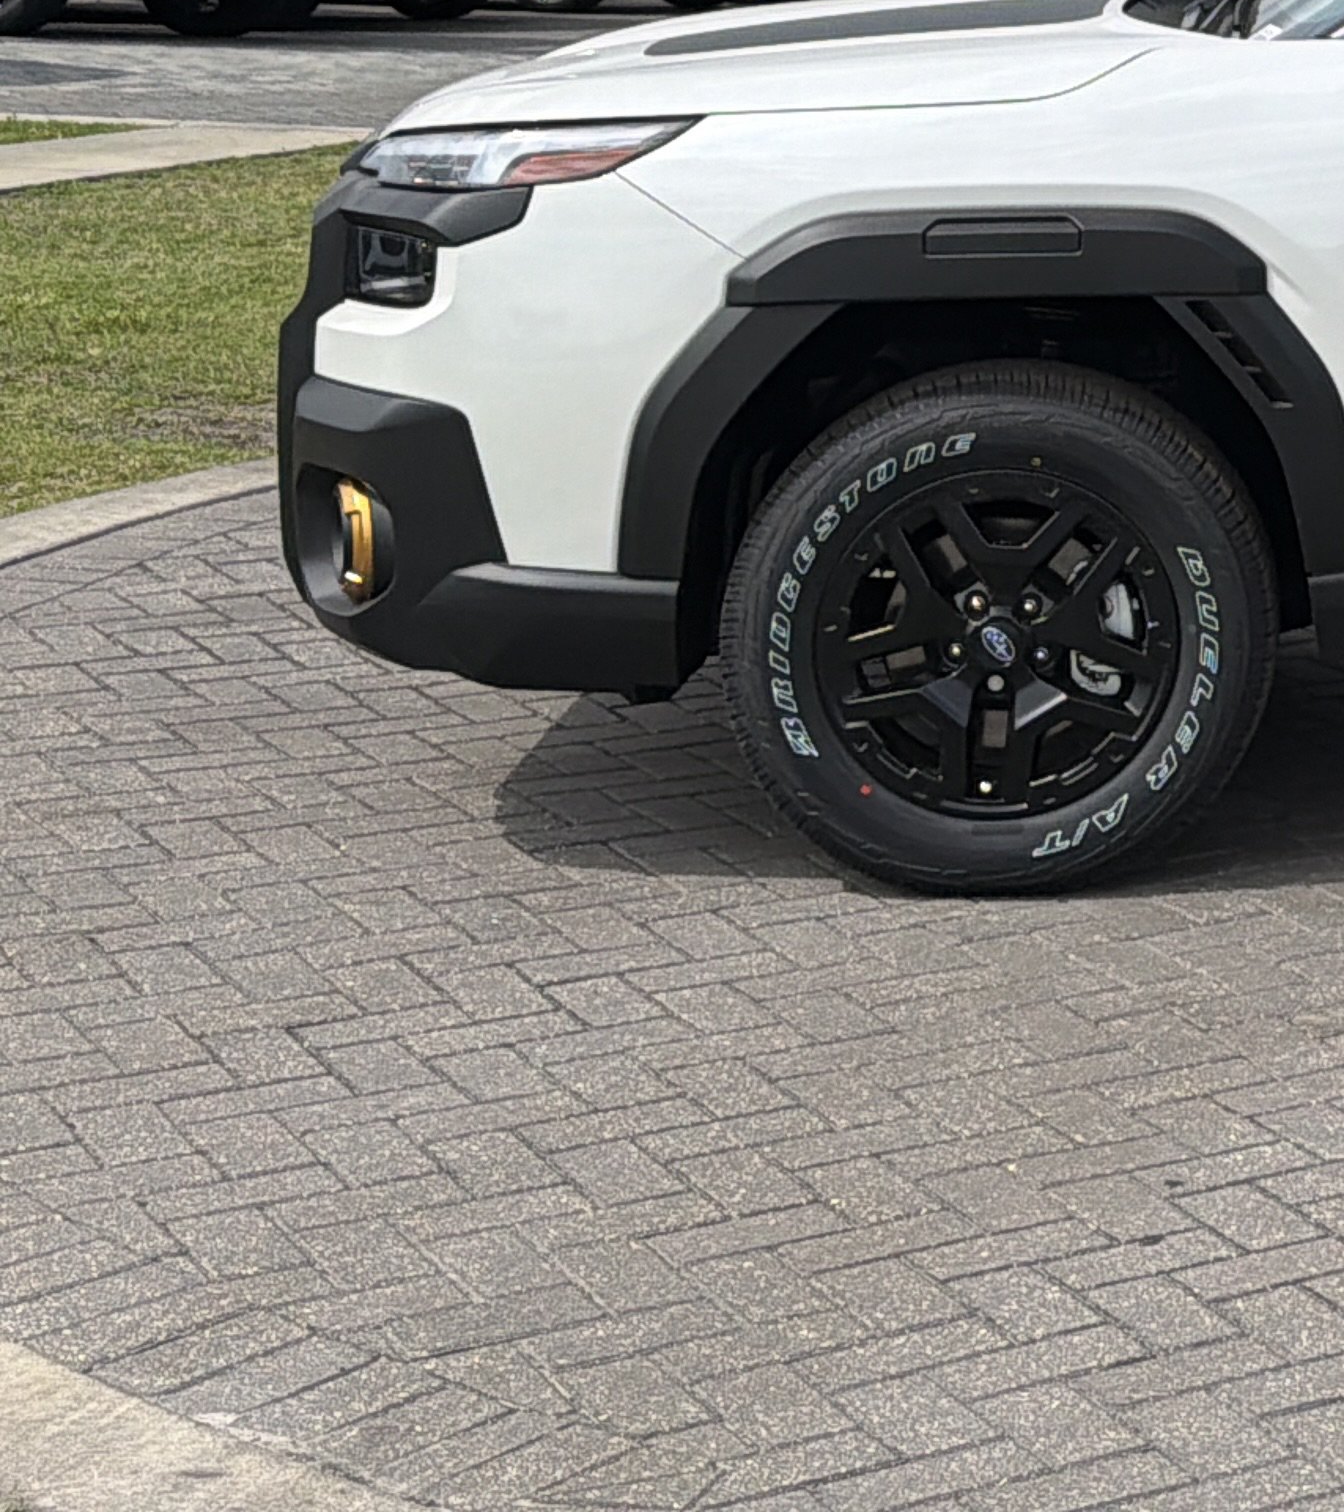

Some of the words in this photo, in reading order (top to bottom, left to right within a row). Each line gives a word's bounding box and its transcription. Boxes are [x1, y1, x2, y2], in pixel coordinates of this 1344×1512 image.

[768, 432, 976, 758] BRIDGESTONE
[1146, 546, 1219, 791] DUELER
[1032, 793, 1129, 858] A/T
